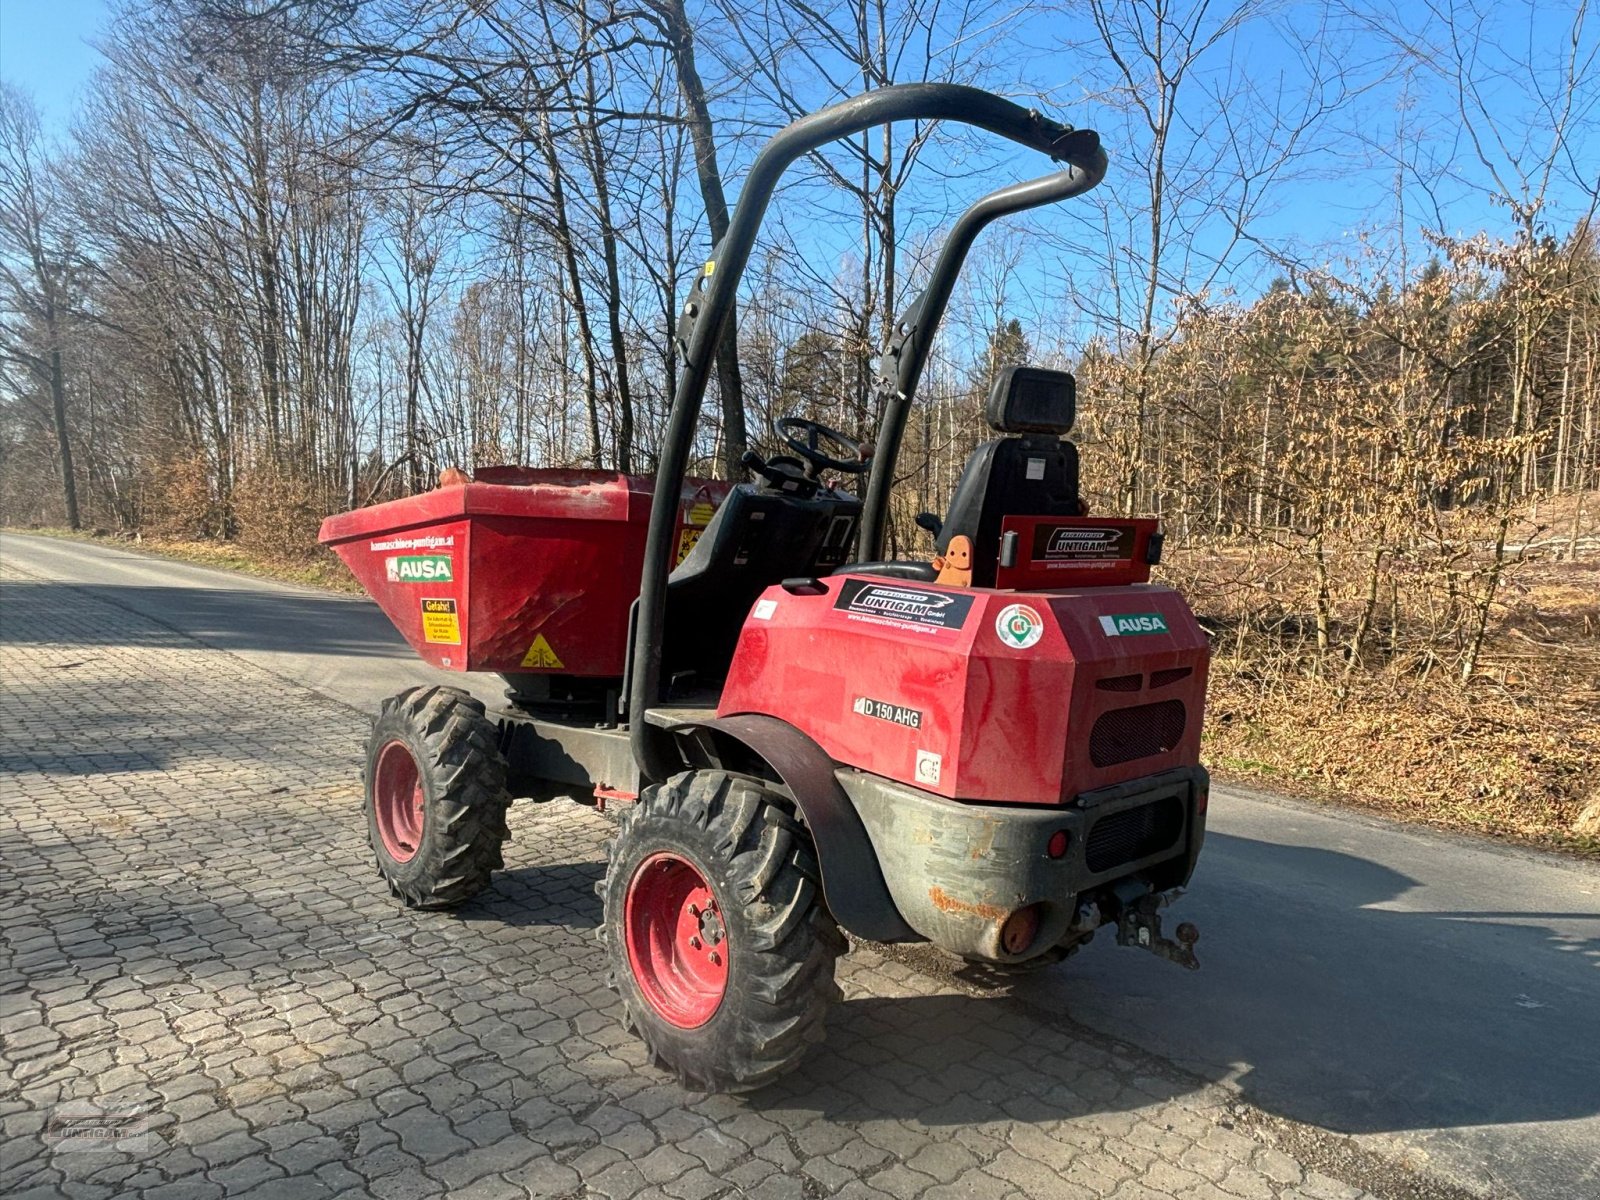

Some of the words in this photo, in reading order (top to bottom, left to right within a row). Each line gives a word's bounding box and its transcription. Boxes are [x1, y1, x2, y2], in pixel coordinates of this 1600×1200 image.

[400, 560, 451, 578] AUSA
[1118, 617, 1166, 632] AUSA
[865, 699, 874, 715] D
[875, 702, 893, 720] 150
[894, 707, 919, 728] AHG
